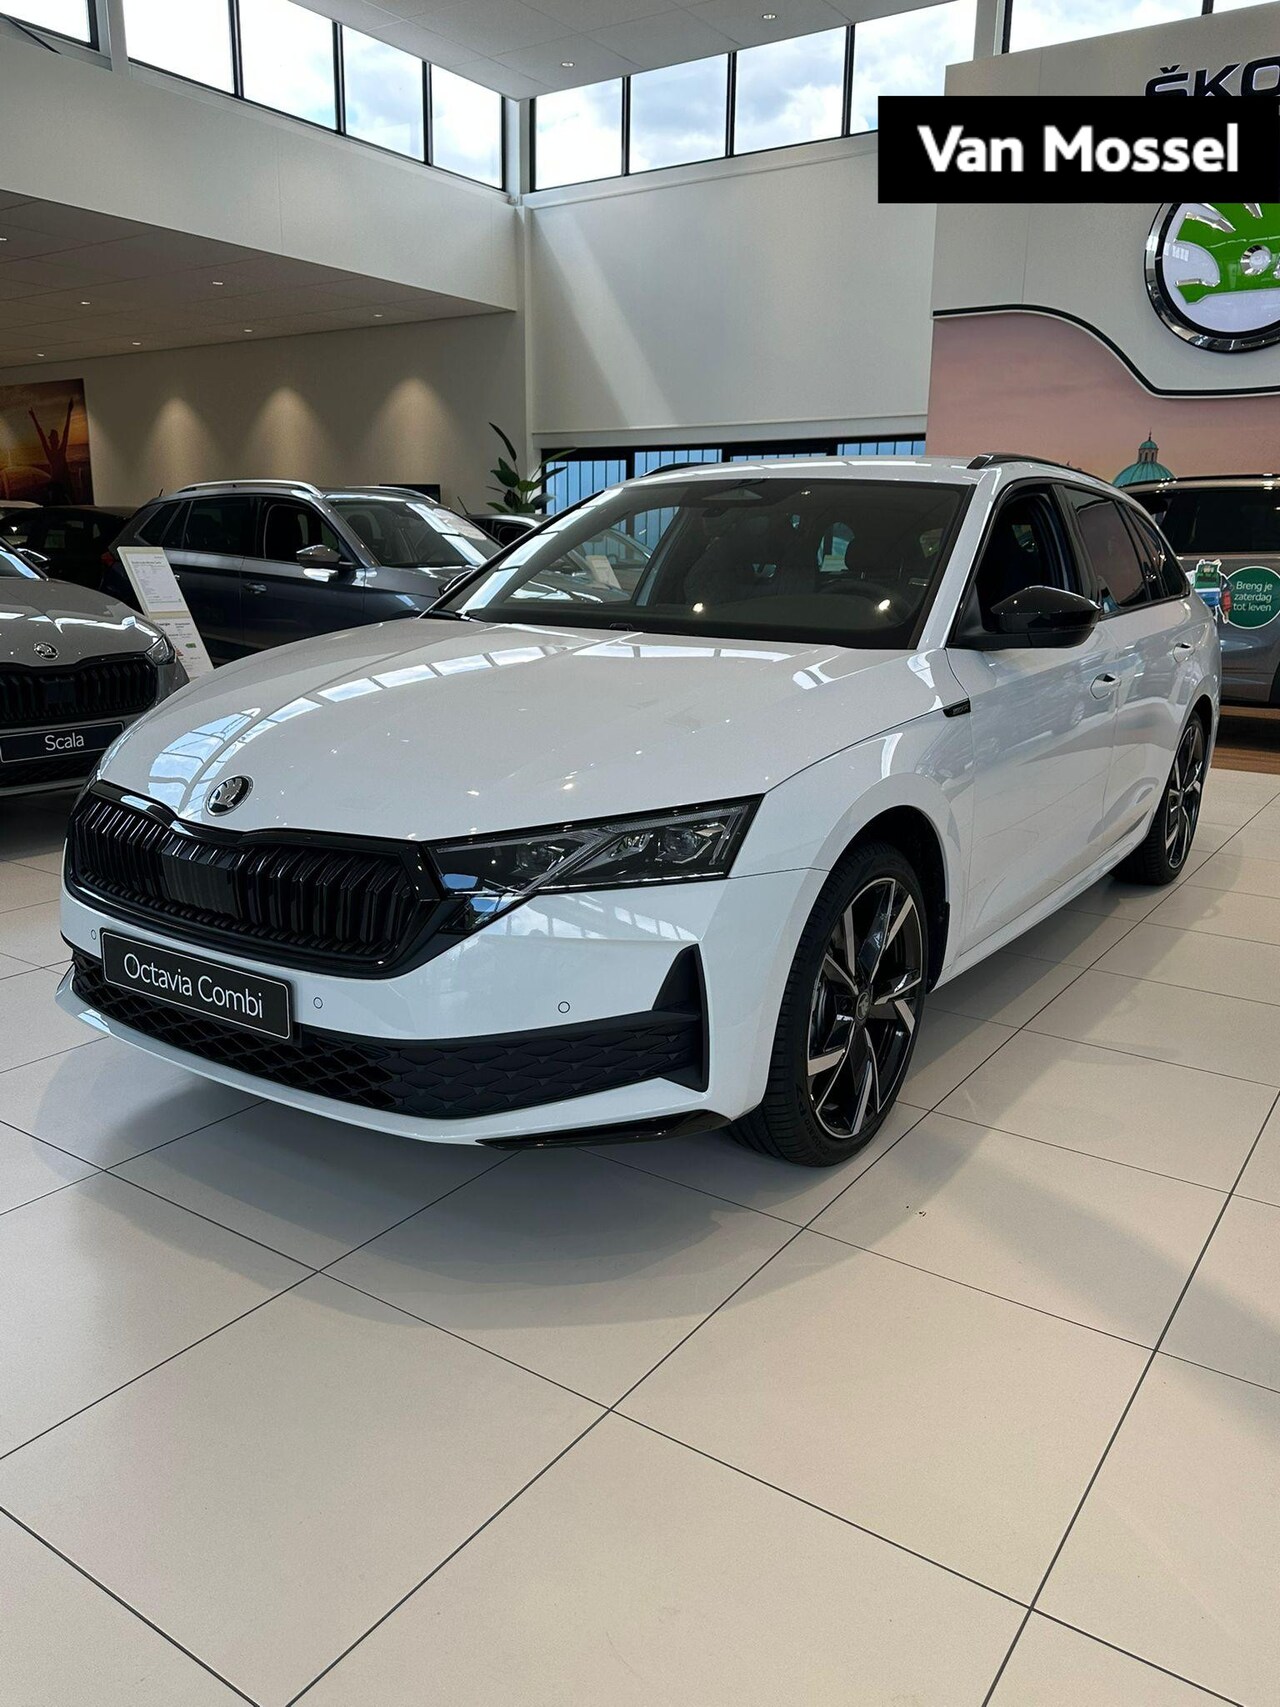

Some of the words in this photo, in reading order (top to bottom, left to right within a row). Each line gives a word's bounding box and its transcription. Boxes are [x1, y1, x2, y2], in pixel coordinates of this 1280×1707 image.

[1236, 581, 1263, 592] Breng
[1264, 581, 1273, 592] je
[1234, 593, 1272, 603] zaterdag
[1233, 603, 1247, 611] tot
[1248, 602, 1272, 611] leven
[44, 732, 85, 751] Scala
[123, 953, 193, 997] Octavia
[197, 975, 264, 1019] Combi
